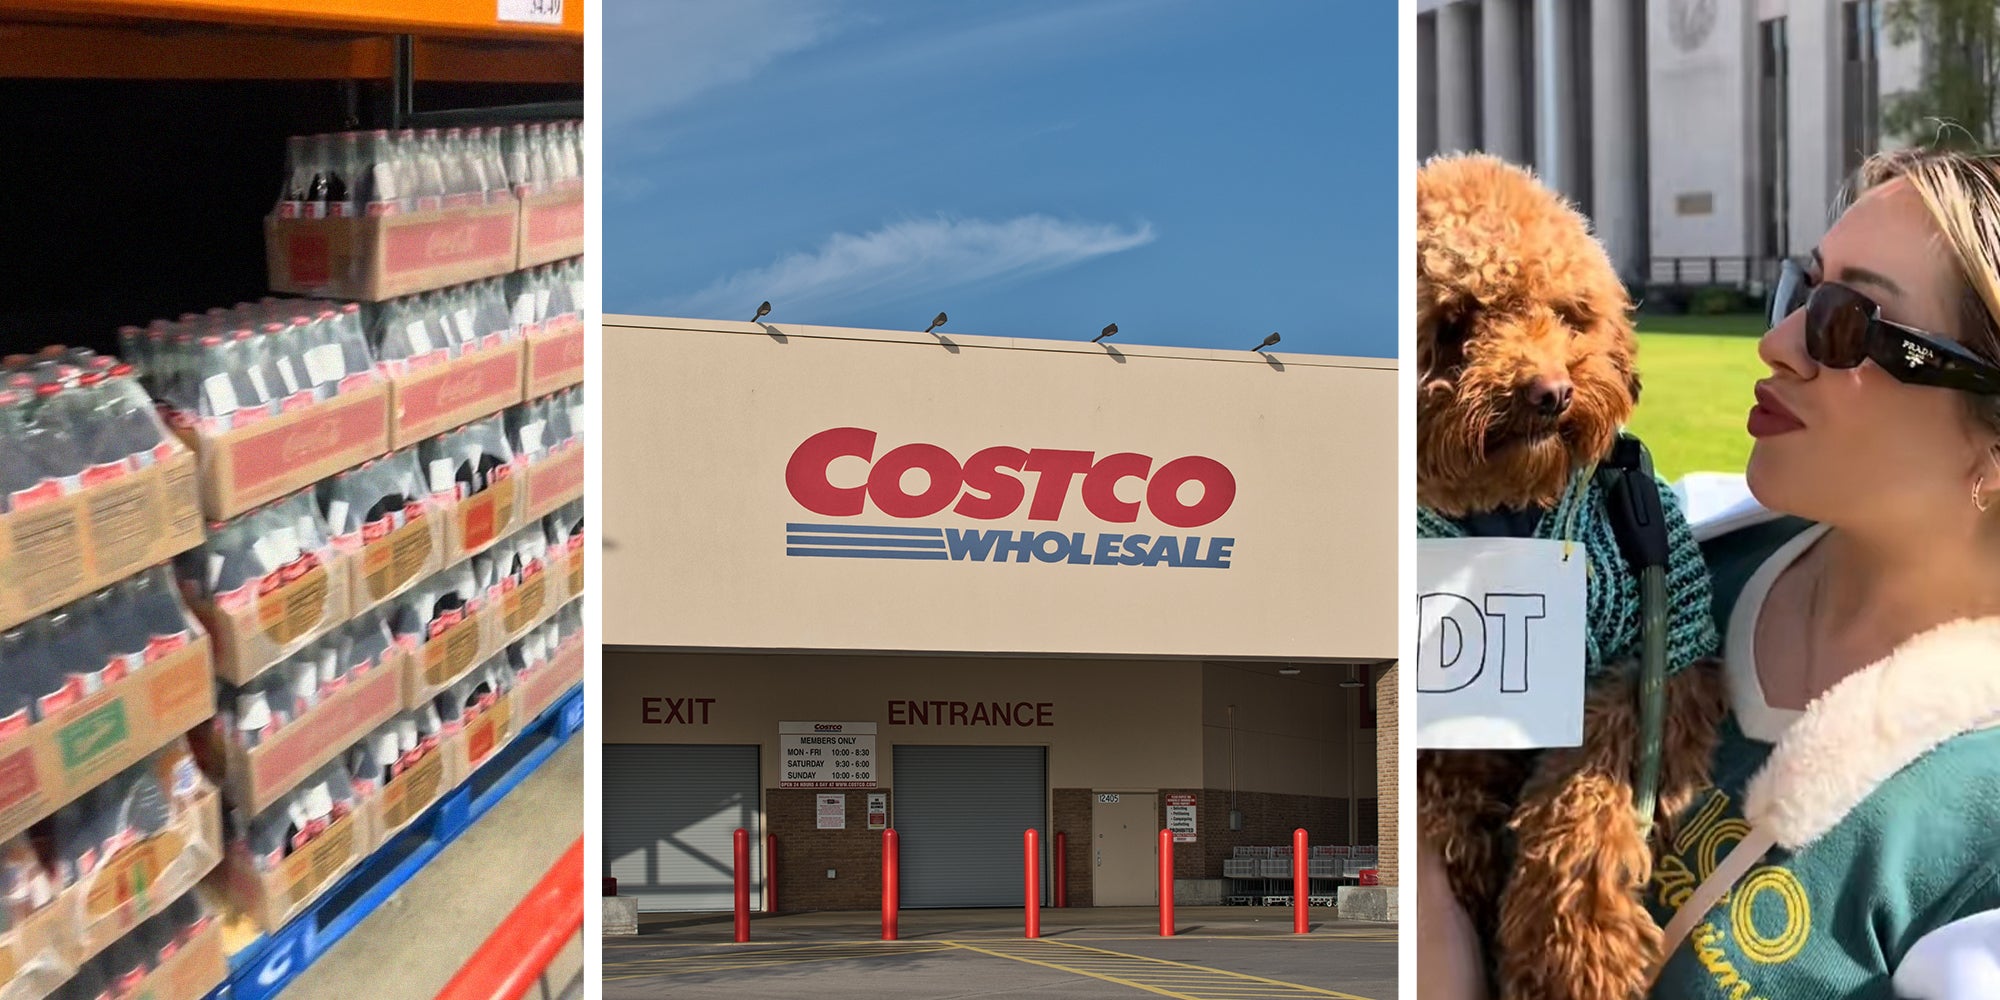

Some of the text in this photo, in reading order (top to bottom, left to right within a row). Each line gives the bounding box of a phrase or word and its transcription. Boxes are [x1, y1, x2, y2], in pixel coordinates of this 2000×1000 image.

[1902, 340, 1933, 358] PRADA
[785, 427, 1236, 528] COSTCO
[944, 528, 1235, 569] WHOLESALE
[1417, 593, 1545, 692] DT
[641, 697, 716, 725] EXIT
[888, 700, 1054, 727] ENTRANCE
[800, 737, 856, 745] MEMBERS ONLY
[787, 760, 824, 768] SATURDAY
[855, 760, 870, 768] 6:00
[787, 771, 816, 779] SUNDAY
[1100, 794, 1118, 803] 12405
